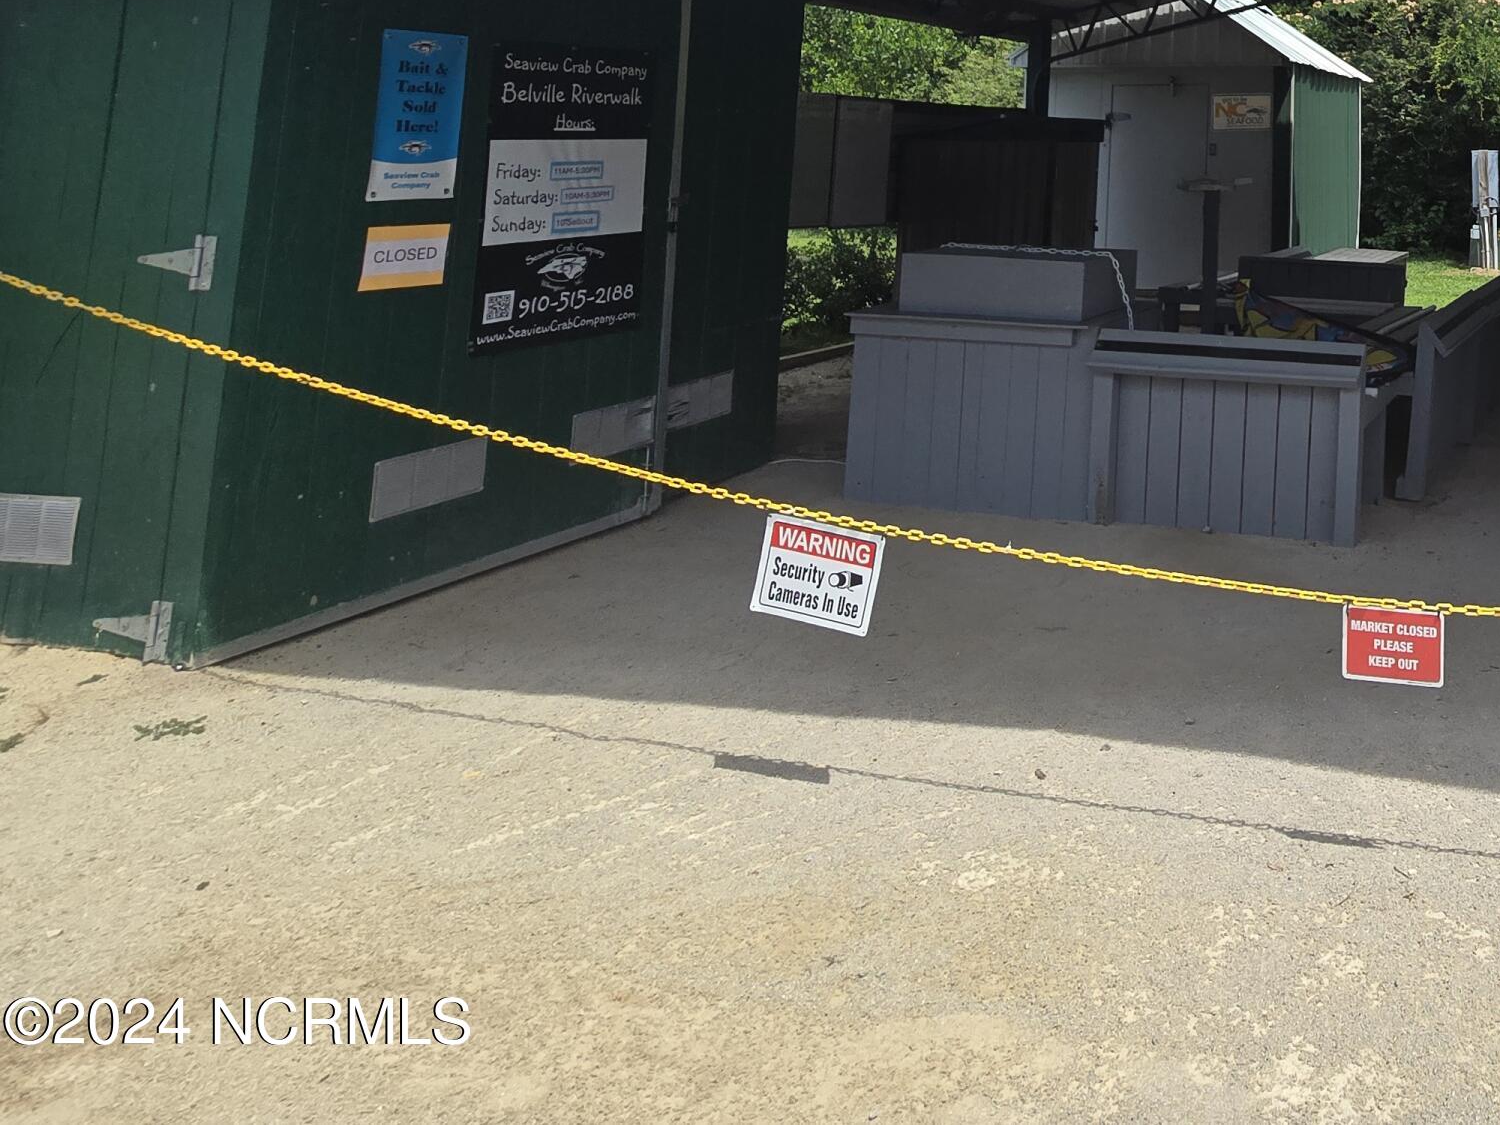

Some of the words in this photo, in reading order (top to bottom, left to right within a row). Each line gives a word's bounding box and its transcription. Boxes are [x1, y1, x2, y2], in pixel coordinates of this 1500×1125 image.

[397, 60, 430, 75] Bait
[436, 62, 449, 76] &
[504, 52, 559, 73] Seaview
[563, 57, 592, 74] Crab
[596, 57, 648, 80] Company
[396, 79, 447, 95] Tackle
[501, 81, 566, 104] Belville
[571, 83, 643, 106] Riverwalk
[402, 100, 437, 114] Sold
[1215, 101, 1248, 118] NC
[394, 119, 439, 133] Here!
[555, 113, 596, 131] Hours:
[1226, 115, 1264, 125] SEAFOOD
[420, 171, 440, 179] Crab
[496, 162, 541, 182] Friday:
[391, 181, 431, 191] Company
[494, 188, 559, 207] Saturday:
[492, 215, 546, 234] Sunday:
[373, 246, 438, 264] CLOSED
[518, 284, 634, 318] 910-515-2188
[476, 312, 636, 345] www.SeaviewCrabCompany.com
[779, 526, 871, 564] WARNING
[773, 556, 826, 588] Security
[768, 581, 819, 610] Cameras
[821, 592, 834, 614] In
[837, 596, 859, 619] Use
[1350, 619, 1394, 635] MARKET
[1396, 624, 1438, 638] CLOSED
[1373, 638, 1414, 653] PLEASE
[1368, 655, 1395, 668] KEEP
[1397, 658, 1419, 671] OUT
